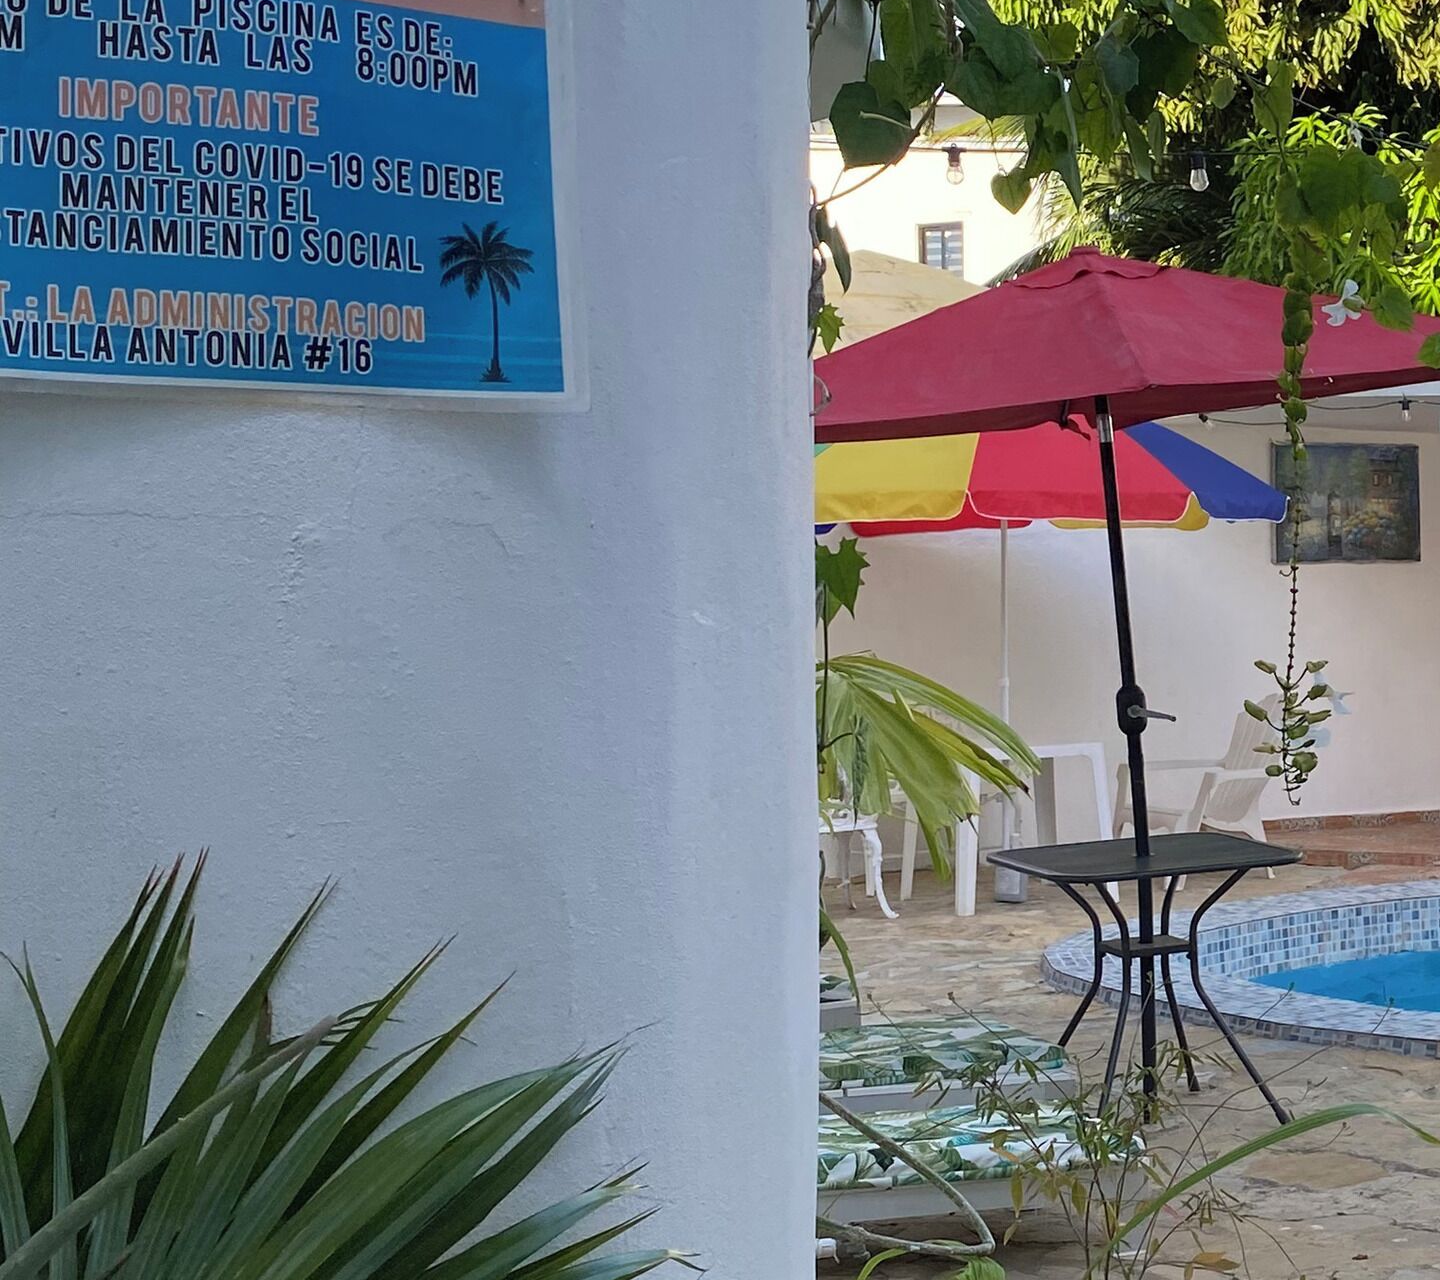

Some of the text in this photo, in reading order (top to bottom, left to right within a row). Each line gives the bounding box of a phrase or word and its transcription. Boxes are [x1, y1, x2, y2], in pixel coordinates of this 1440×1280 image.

[97, 20, 220, 66] HASTA
[245, 31, 313, 74] LAS
[355, 47, 479, 98] 8:00PM
[354, 10, 394, 51] ES
[403, 17, 453, 60] DE:
[58, 76, 320, 137] IMPORTANTE
[59, 172, 320, 225] MANTENER EL
[114, 133, 183, 175] DEL
[193, 140, 365, 190] COVID-19
[372, 156, 413, 195] SE
[421, 161, 504, 205] DEBE
[0, 209, 425, 274] TANCIAMIENTO SOCIAL
[47, 283, 96, 325] LA
[107, 287, 426, 343] ADMINISTRACION
[1, 321, 374, 375] VILLA ANTONIA #16
